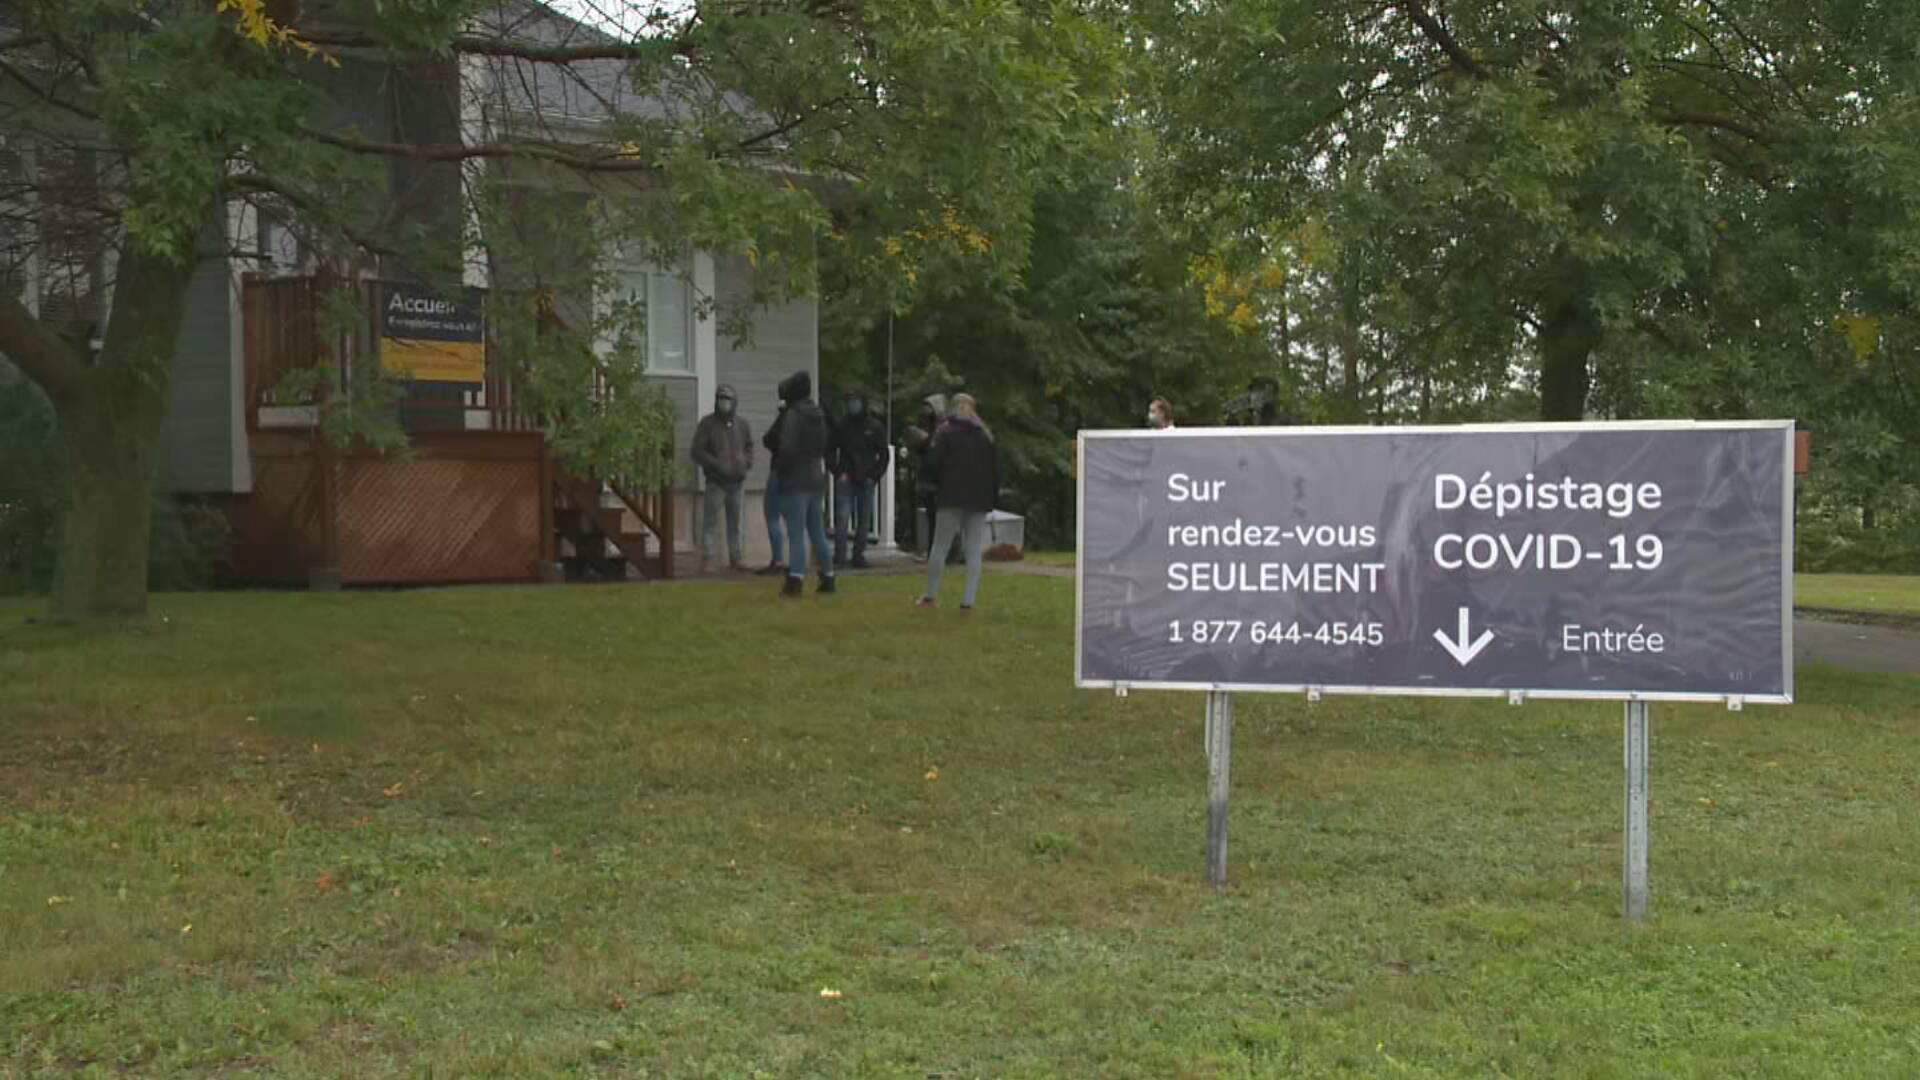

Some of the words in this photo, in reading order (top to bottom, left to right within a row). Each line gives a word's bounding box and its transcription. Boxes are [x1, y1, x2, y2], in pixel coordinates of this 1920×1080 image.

[1167, 472, 1227, 502] Sur
[1434, 470, 1662, 518] Dépistage
[1167, 517, 1377, 547] rendez-vous
[1433, 533, 1664, 570] COVID-19
[1167, 562, 1386, 593] SEULEMENT
[1169, 619, 1184, 643] 1
[1191, 620, 1243, 644] 877
[1250, 620, 1384, 645] 644-4545
[1562, 623, 1665, 653] Entrée
